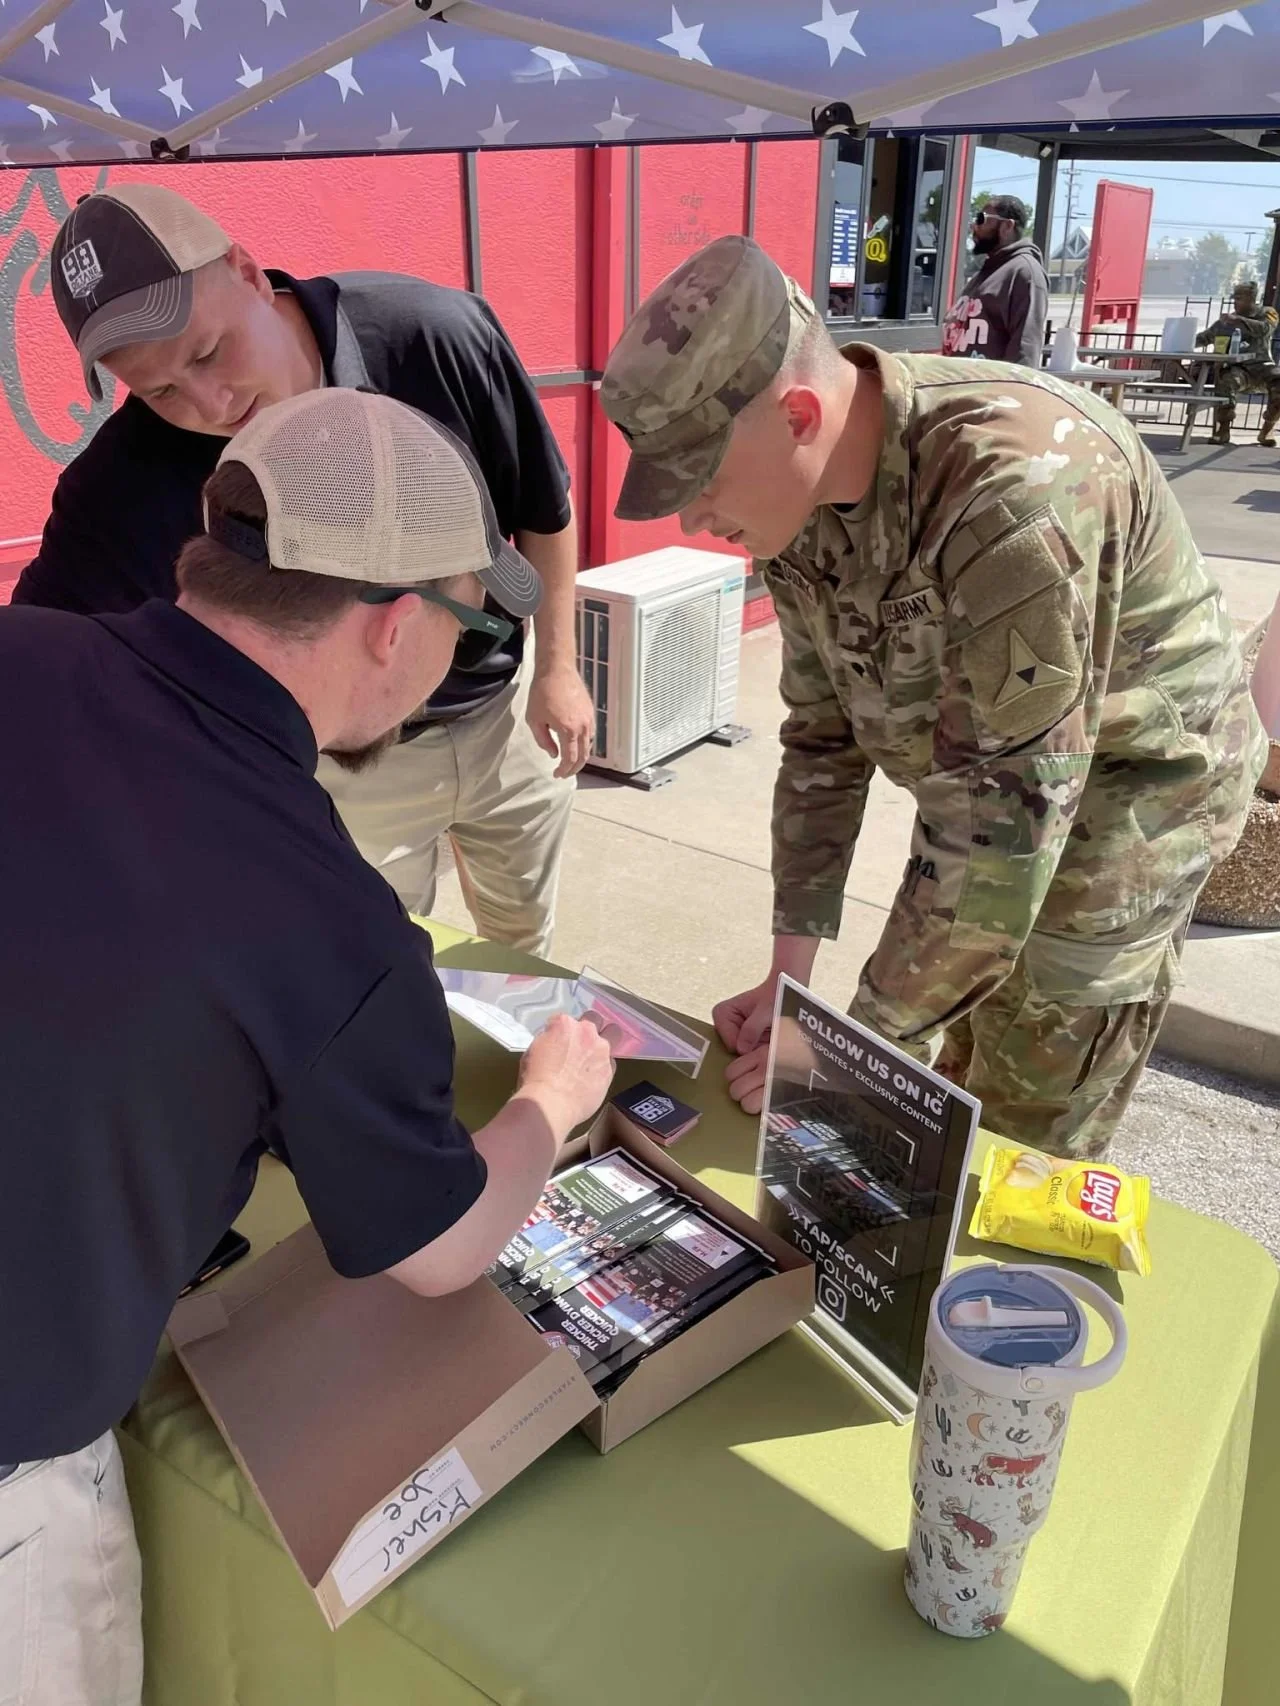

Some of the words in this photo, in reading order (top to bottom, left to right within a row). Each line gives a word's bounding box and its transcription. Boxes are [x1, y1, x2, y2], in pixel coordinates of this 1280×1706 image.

[63, 242, 94, 282] 98
[865, 238, 887, 262] Q
[798, 1008, 864, 1061] FOLLOW
[866, 1054, 889, 1080] US
[893, 1074, 920, 1100] ON
[924, 1091, 944, 1116] IG
[632, 1101, 663, 1120] 98
[813, 1042, 848, 1070] UPDATES
[855, 1070, 900, 1107] EXCLUSIVE
[900, 1101, 943, 1135] CONTENT
[1046, 1176, 1063, 1205] Classic
[1080, 1172, 1120, 1220] Lay's
[793, 1229, 812, 1254] TO
[816, 1250, 880, 1313] FOLLOW
[802, 1215, 878, 1289] TAP/SCAN
[561, 1319, 599, 1351] THICKER
[577, 1317, 610, 1343] SICKER
[580, 1305, 619, 1336] QUICKER
[383, 1468, 433, 1521] Joe
[383, 1486, 471, 1572] Fisher
